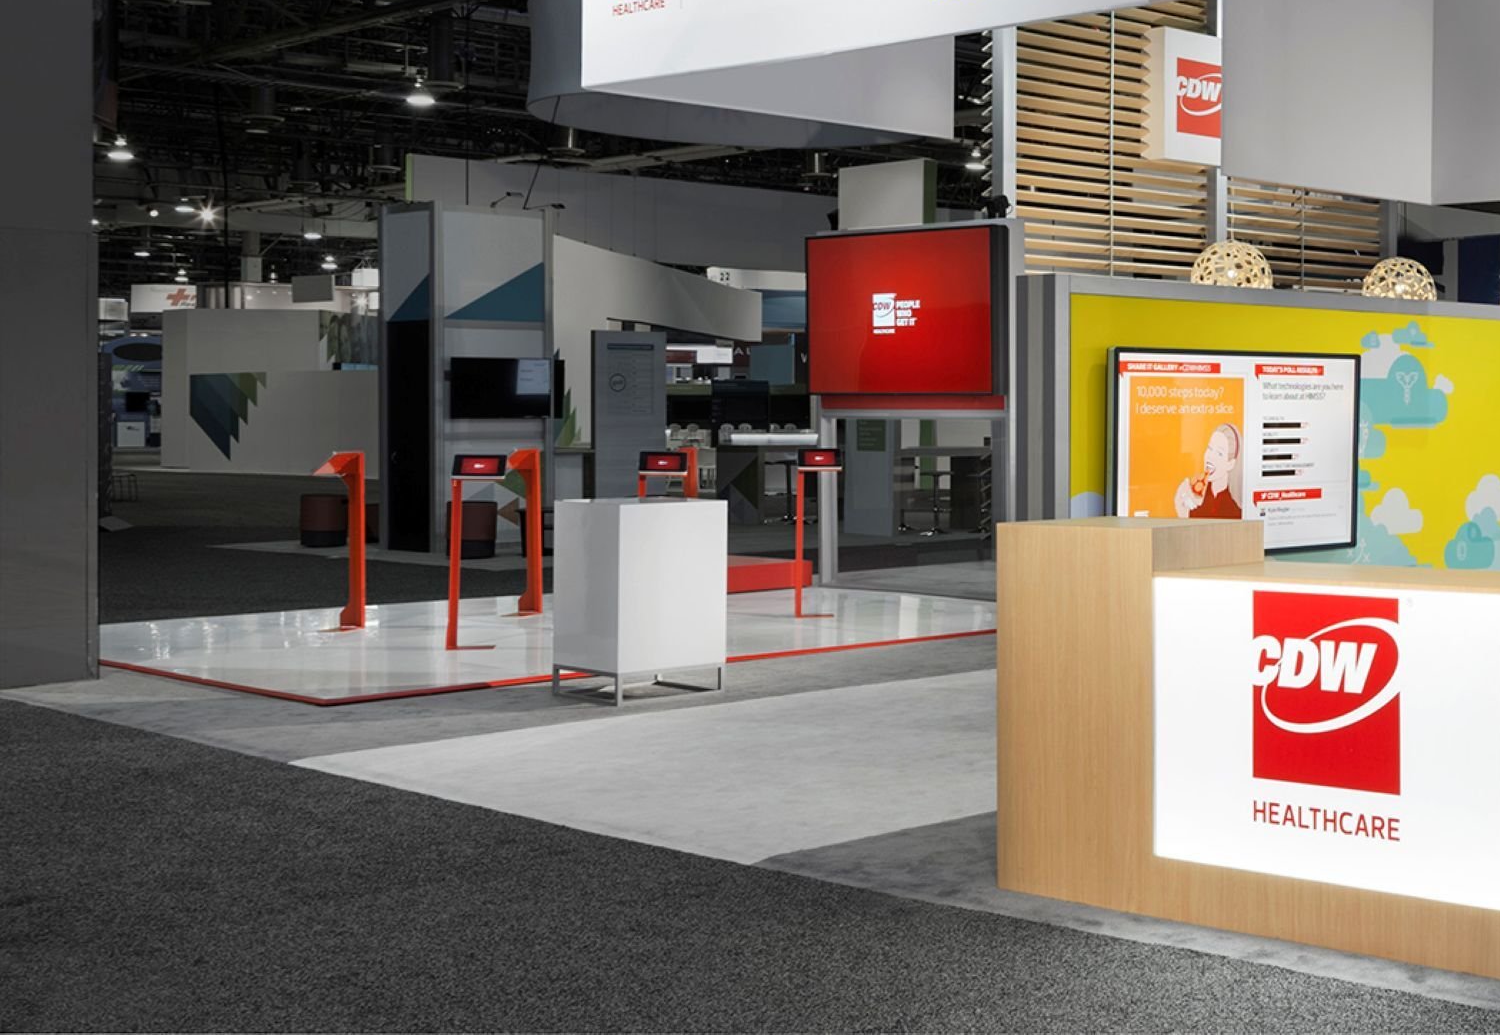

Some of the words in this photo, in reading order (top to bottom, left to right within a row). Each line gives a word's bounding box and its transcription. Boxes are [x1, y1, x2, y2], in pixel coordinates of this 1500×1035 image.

[1176, 75, 1222, 102] CDW
[873, 302, 891, 311] CDW
[896, 300, 920, 309] PEOPLE
[1136, 386, 1168, 398] 10,000
[1168, 387, 1194, 399] steps
[1194, 387, 1225, 400] today?
[1139, 403, 1178, 414] deserve
[1190, 405, 1215, 414] extra
[1251, 634, 1378, 694] CDW
[1252, 799, 1401, 842] HEALTHCARE
